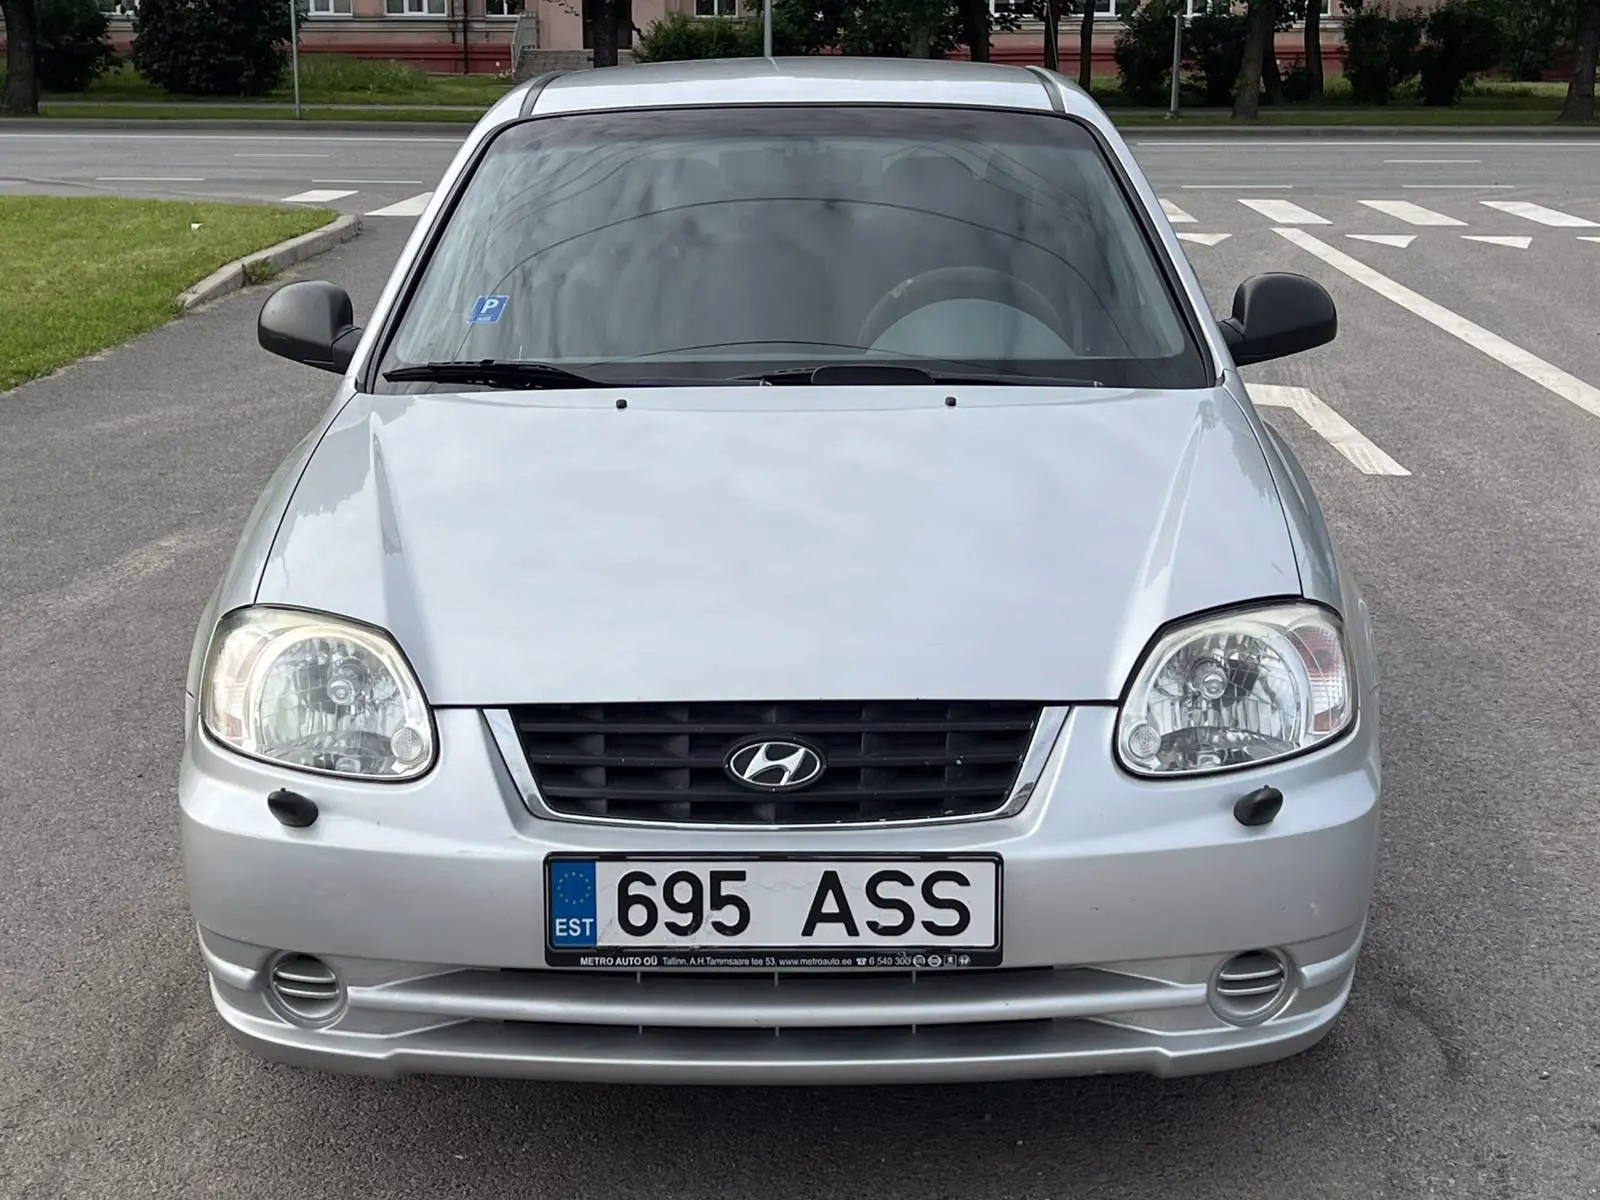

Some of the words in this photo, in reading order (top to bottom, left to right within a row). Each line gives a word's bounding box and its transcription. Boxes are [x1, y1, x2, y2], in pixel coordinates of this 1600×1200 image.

[480, 299, 499, 314] P
[617, 870, 750, 937] 695
[801, 870, 971, 937] ASS
[555, 918, 594, 937] EST
[580, 956, 614, 966] METRO
[615, 956, 642, 966] AUTO
[643, 955, 658, 966] OÜ
[778, 957, 853, 966] www.metroauto.ee
[868, 956, 875, 966] 6
[877, 956, 893, 966] 540
